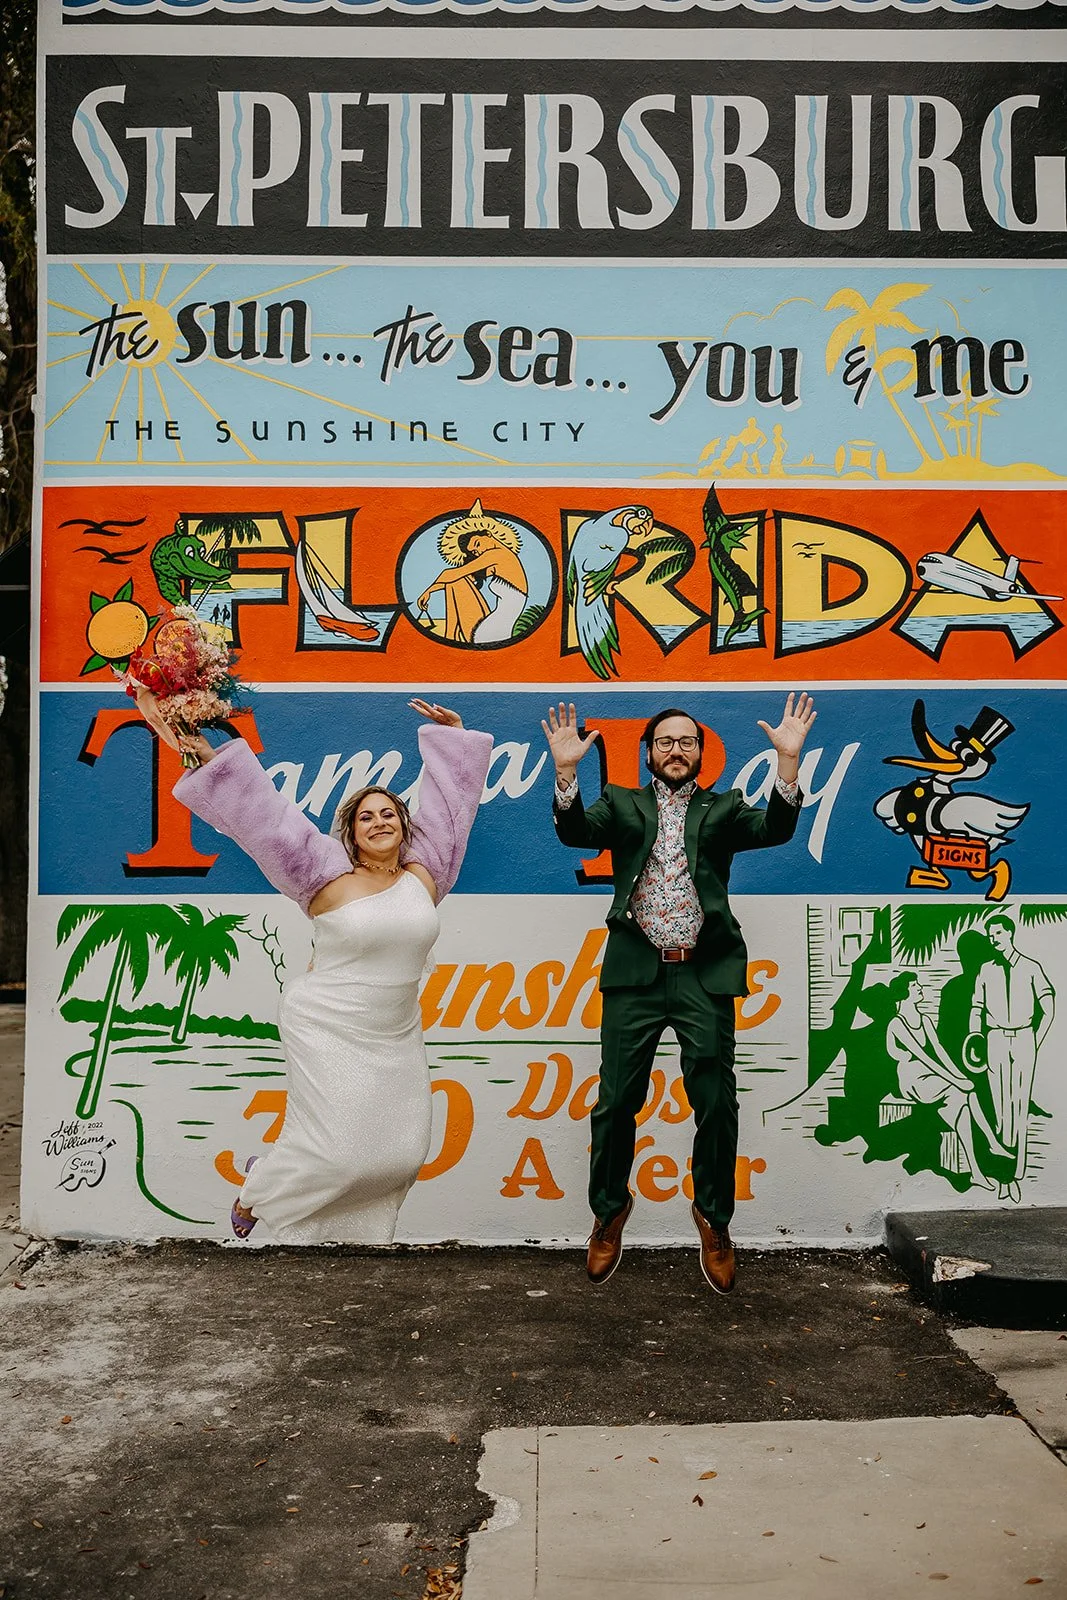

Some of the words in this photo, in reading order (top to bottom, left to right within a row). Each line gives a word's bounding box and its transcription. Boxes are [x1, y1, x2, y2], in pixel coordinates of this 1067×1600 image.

[215, 90, 1067, 232] PETERSBURG
[649, 340, 803, 424] you
[842, 344, 878, 409] &
[911, 334, 1031, 403] me
[105, 420, 181, 441] THE
[492, 421, 585, 442] CITY
[178, 505, 1065, 663] FLORIDA
[77, 708, 547, 877] Tama
[937, 847, 982, 864] SIGNS
[41, 1134, 105, 1156] Williams
[50, 1119, 80, 1139] Jeff
[87, 1121, 104, 1131] 2022
[500, 1137, 565, 1200] A
